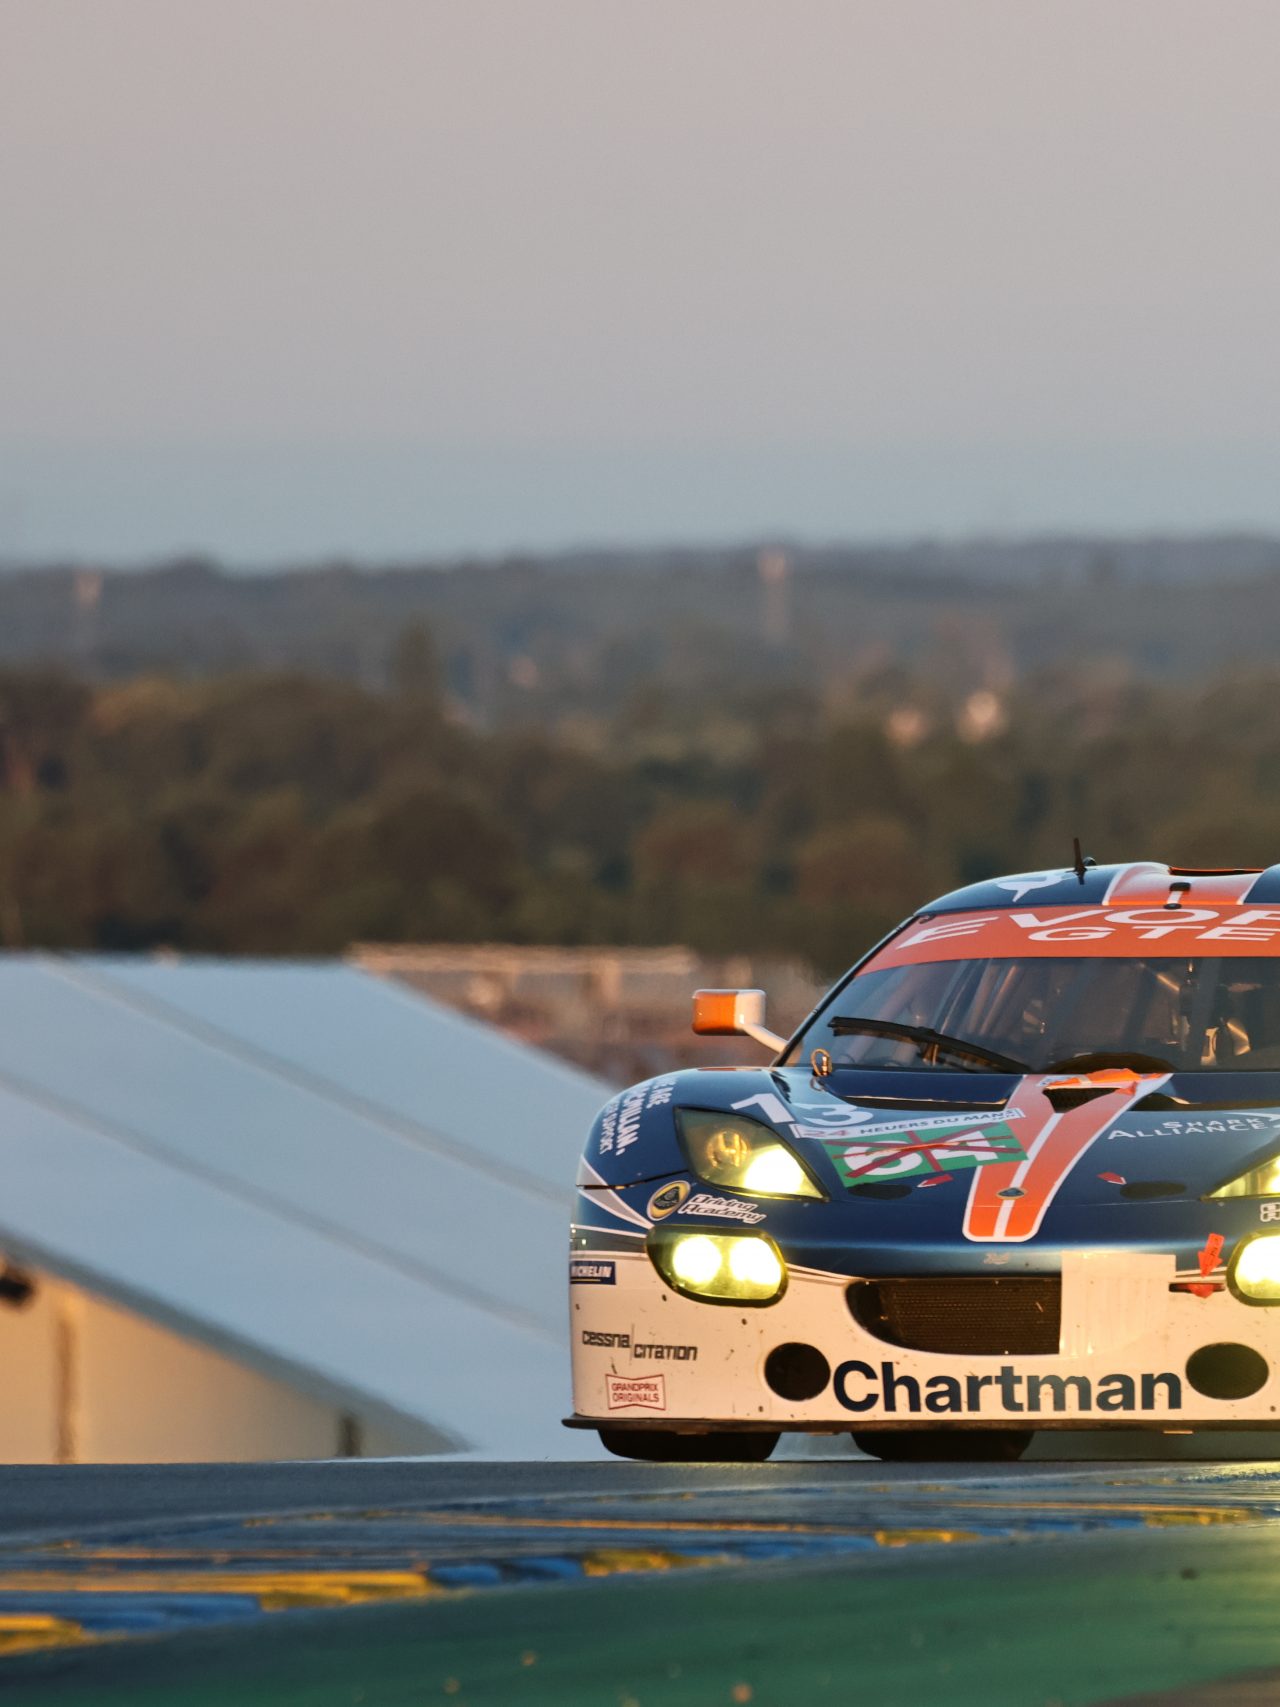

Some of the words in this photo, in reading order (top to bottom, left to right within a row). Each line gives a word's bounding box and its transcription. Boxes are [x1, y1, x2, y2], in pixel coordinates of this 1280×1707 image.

[731, 1093, 874, 1128] 13
[933, 1117, 959, 1126] DU
[1163, 1117, 1262, 1129] SHARK
[1107, 1123, 1269, 1140] ALLIANCE
[690, 1194, 757, 1212] Driving
[680, 1203, 765, 1223] Academy
[833, 1359, 1183, 1413] Chartman
[612, 1392, 660, 1403] ORIGINALS
